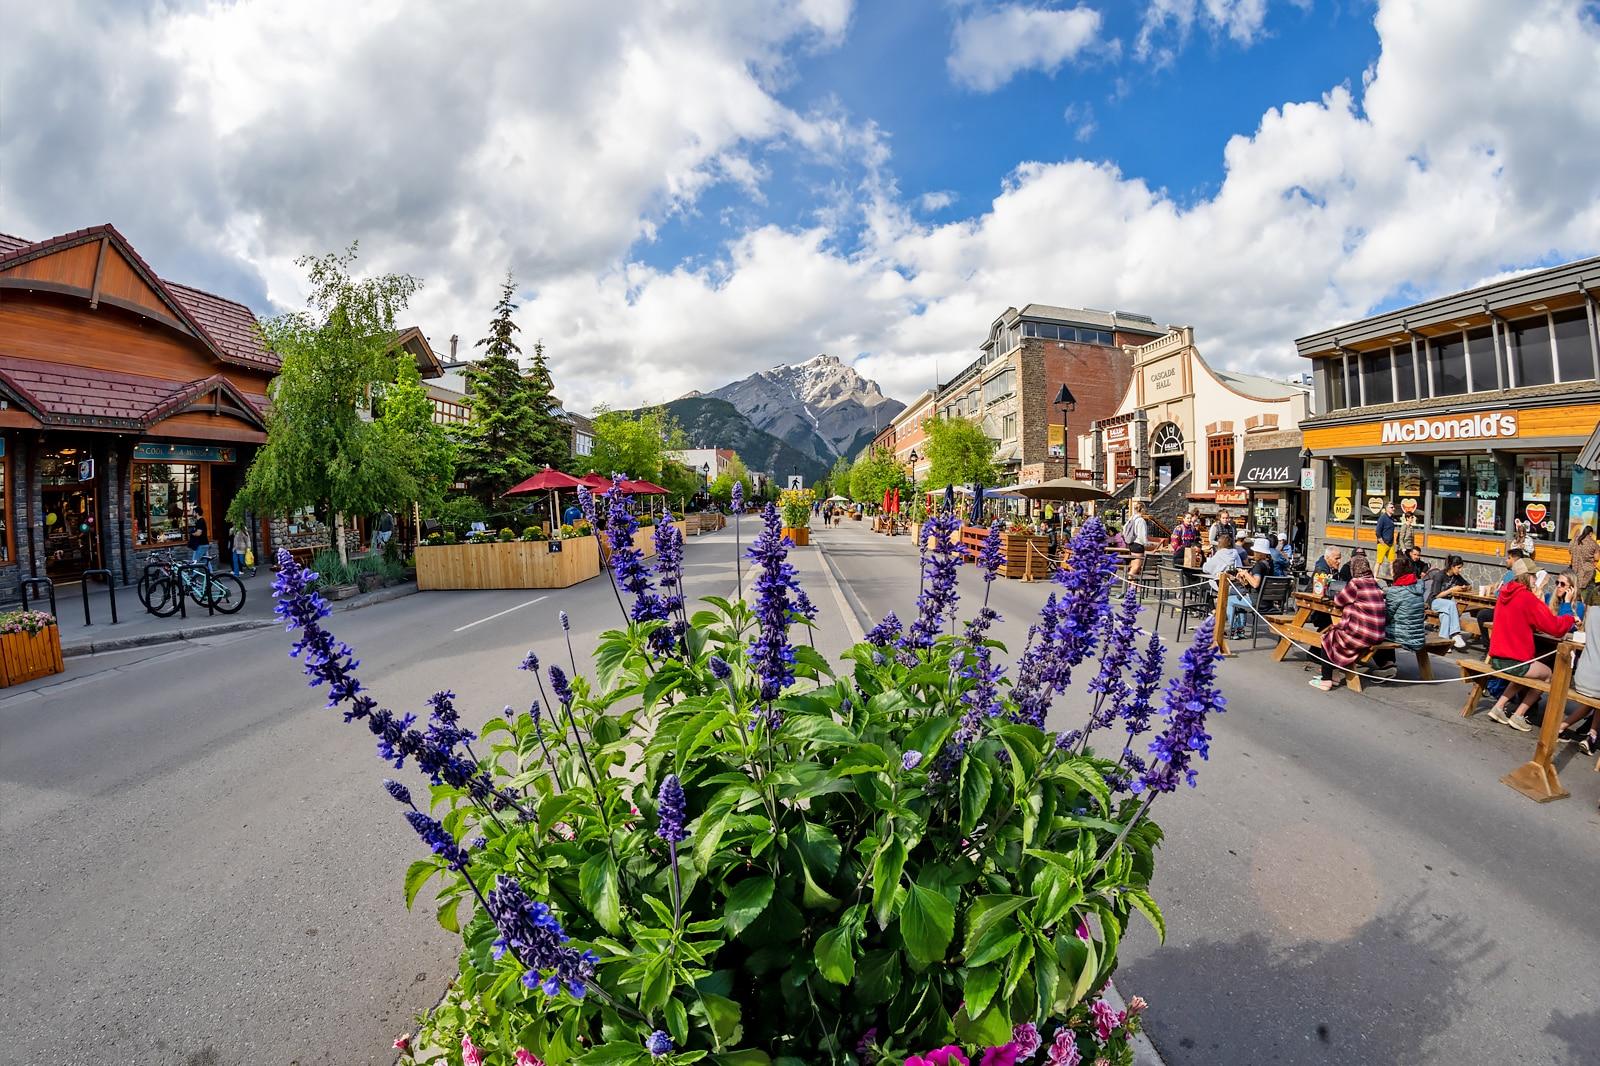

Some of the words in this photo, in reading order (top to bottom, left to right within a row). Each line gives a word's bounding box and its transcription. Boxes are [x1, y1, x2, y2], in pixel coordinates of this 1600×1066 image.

[1151, 368, 1176, 382] CASCADE
[1156, 379, 1171, 390] HALL
[1381, 413, 1516, 443] McDonald's
[1247, 466, 1289, 480] CHAYA
